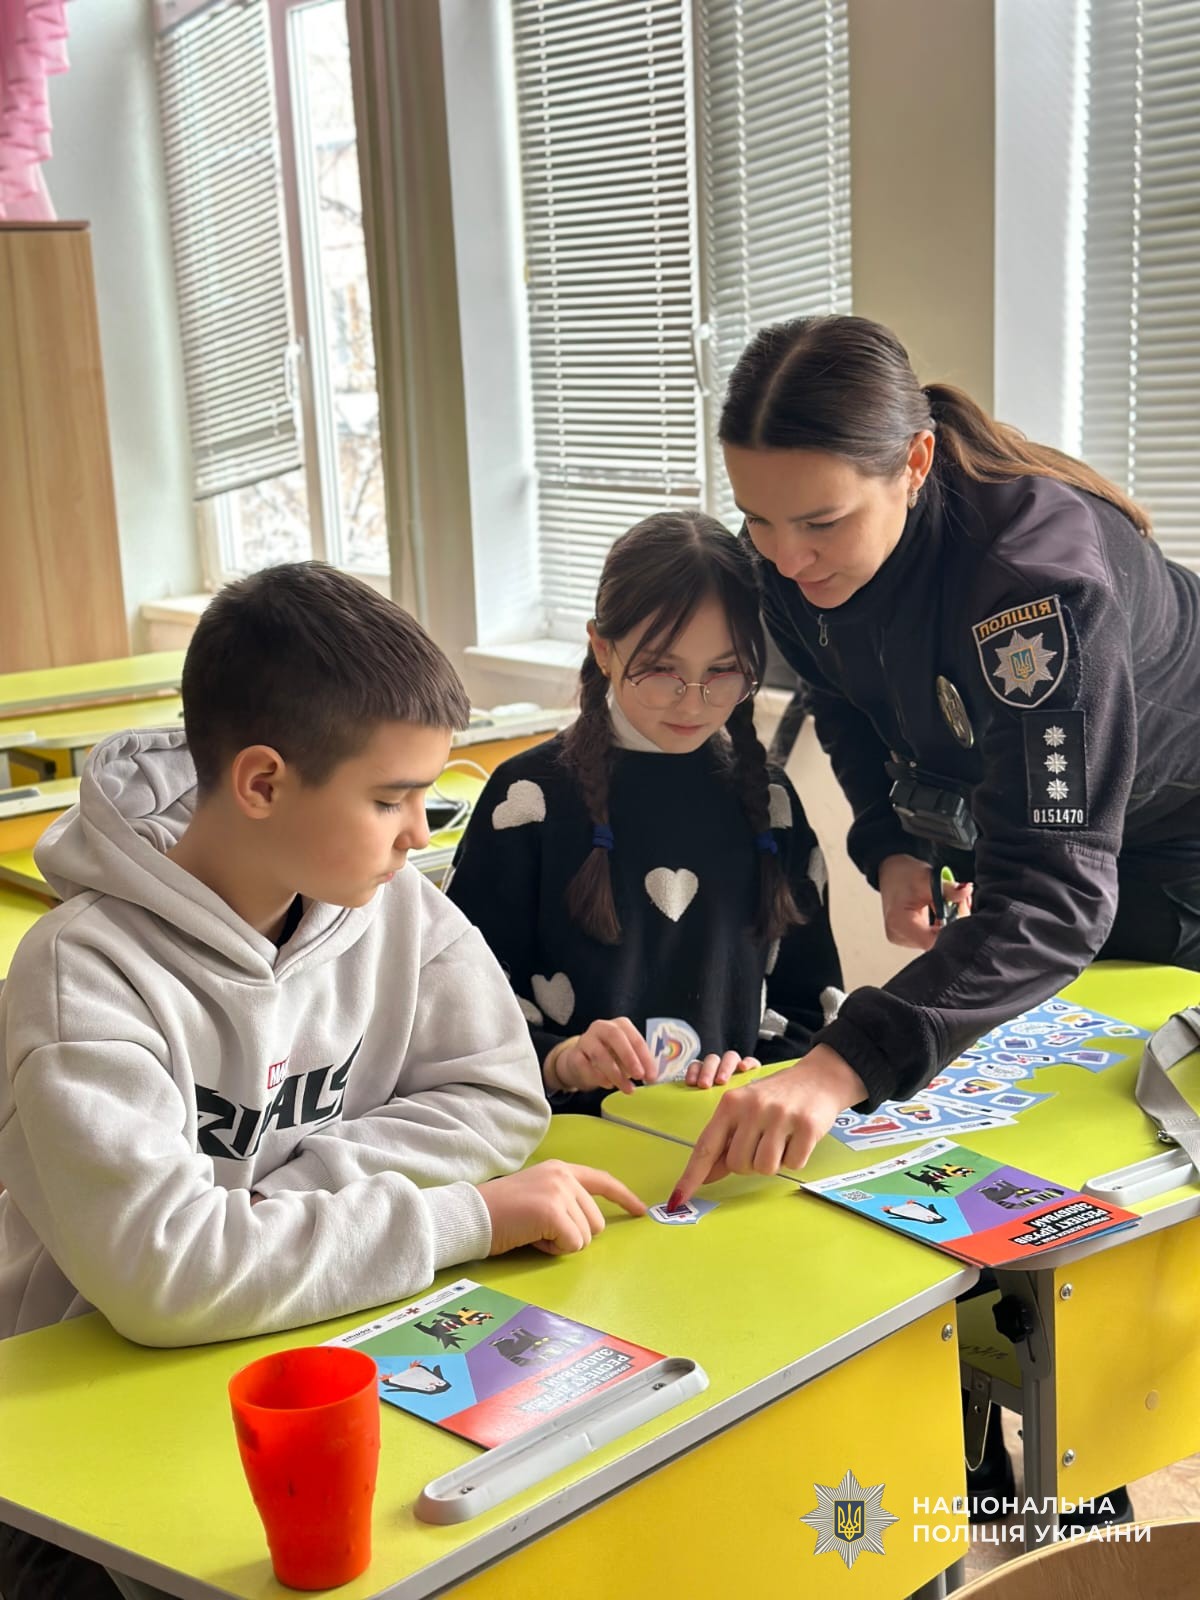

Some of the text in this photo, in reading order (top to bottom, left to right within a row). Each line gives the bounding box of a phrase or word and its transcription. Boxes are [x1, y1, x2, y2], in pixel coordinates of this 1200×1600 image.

[978, 600, 1053, 639] ПОЛІЦІЯ
[1032, 808, 1085, 825] 0151470
[195, 1034, 363, 1160] RIALS
